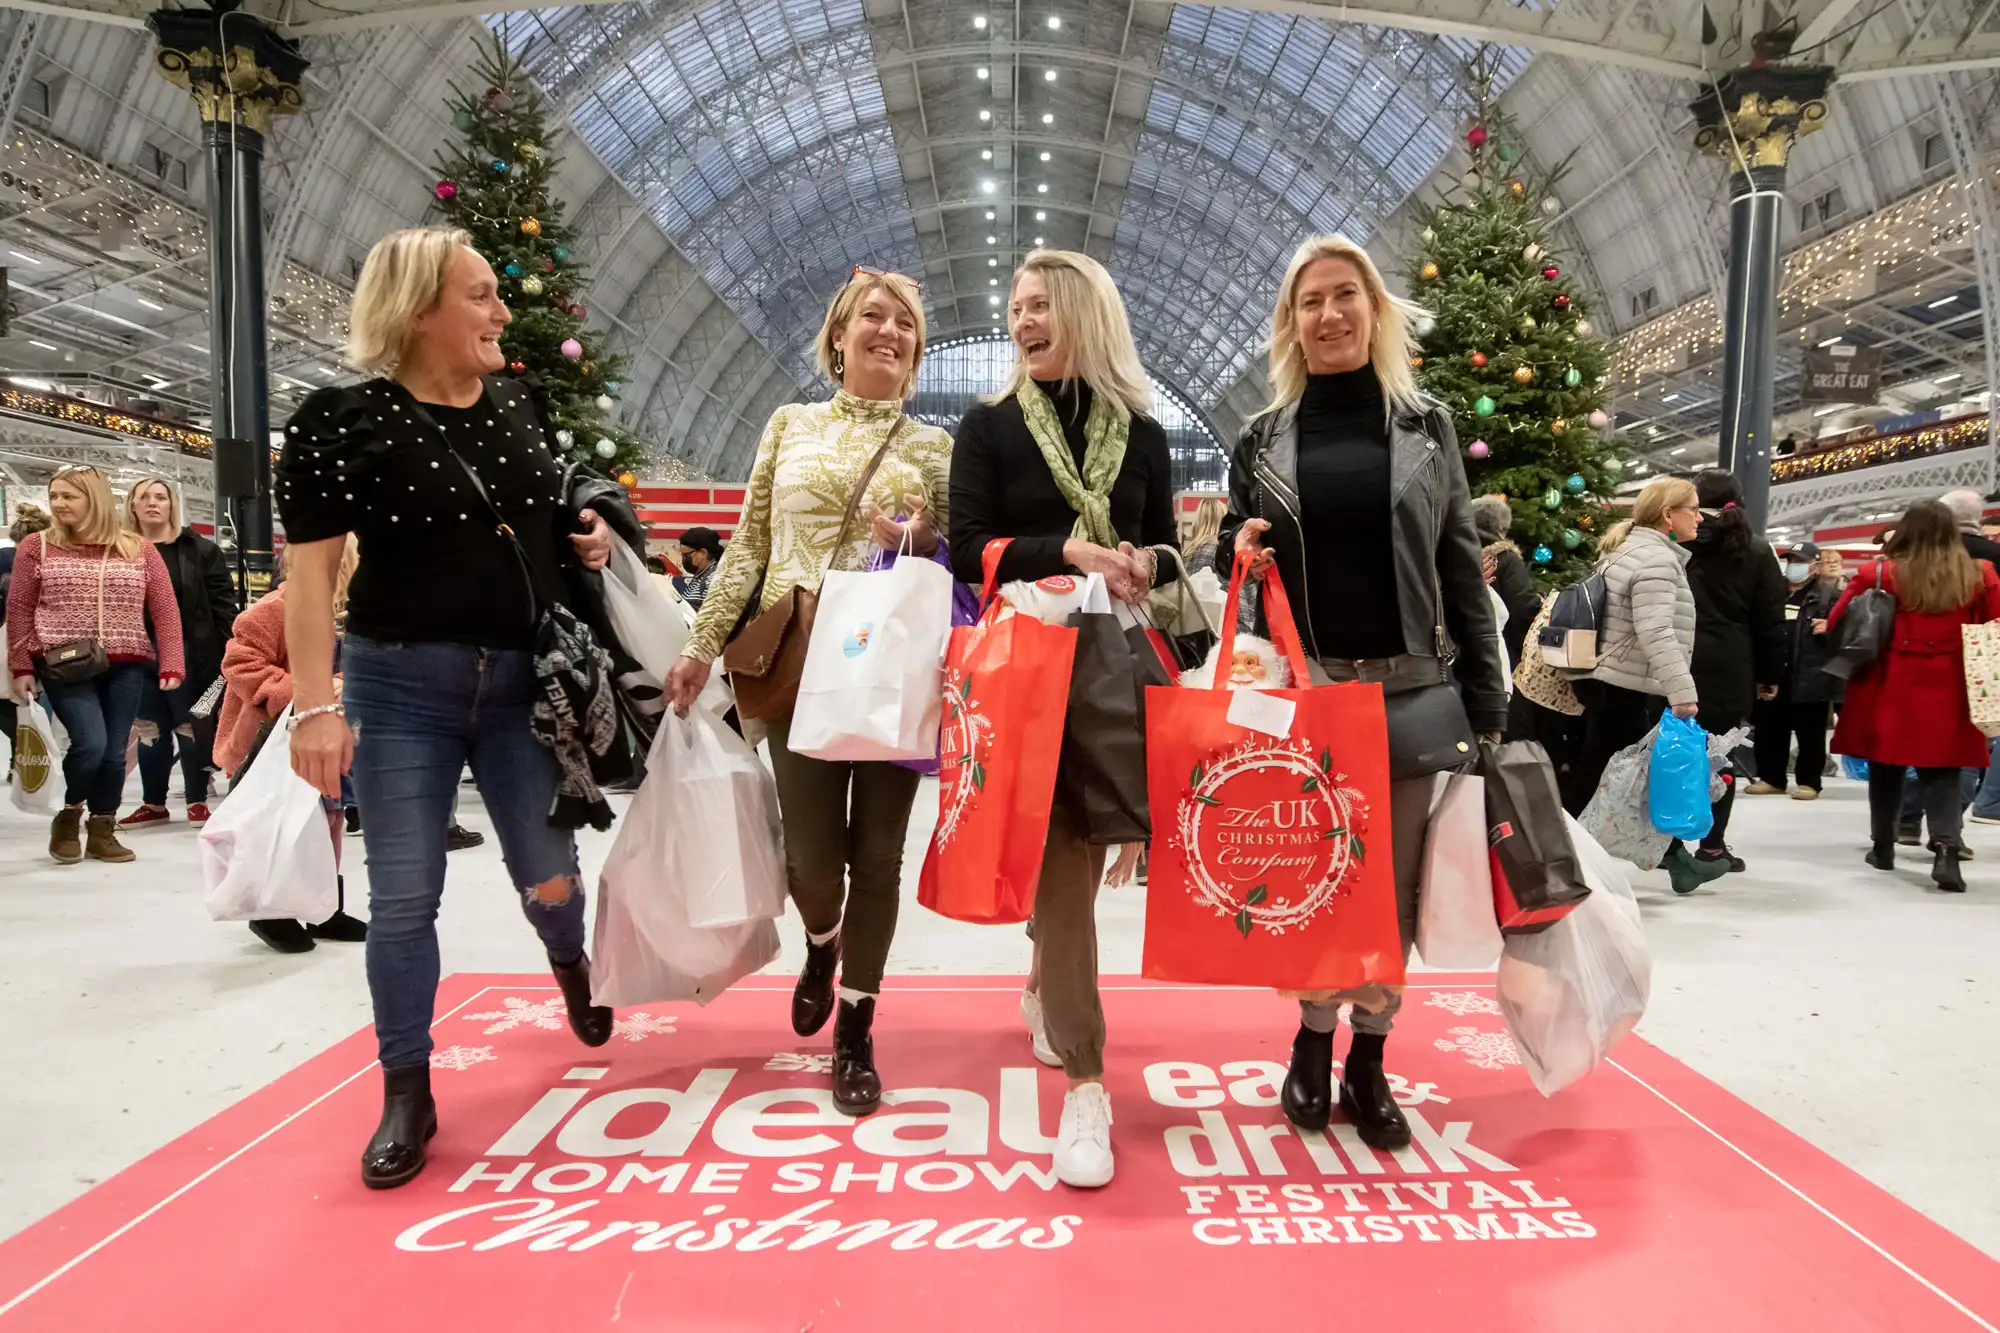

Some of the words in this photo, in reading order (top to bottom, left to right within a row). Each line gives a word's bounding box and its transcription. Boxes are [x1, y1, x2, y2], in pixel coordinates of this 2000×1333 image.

[1813, 374, 1846, 387] GREAT
[1850, 374, 1870, 388] EAT
[1218, 804, 1271, 829] The
[1272, 798, 1320, 829] UK
[1217, 832, 1320, 846] CHRISTMAS
[1217, 847, 1318, 881] Company
[484, 1067, 1057, 1157] ideal
[1163, 1111, 1520, 1177] drink
[447, 1163, 750, 1193] HOME
[770, 1163, 1059, 1192] SHOW
[1180, 1180, 1571, 1215] FESTIVAL
[394, 1199, 1083, 1253] Christmas
[1192, 1212, 1598, 1246] CHRISTMAS
